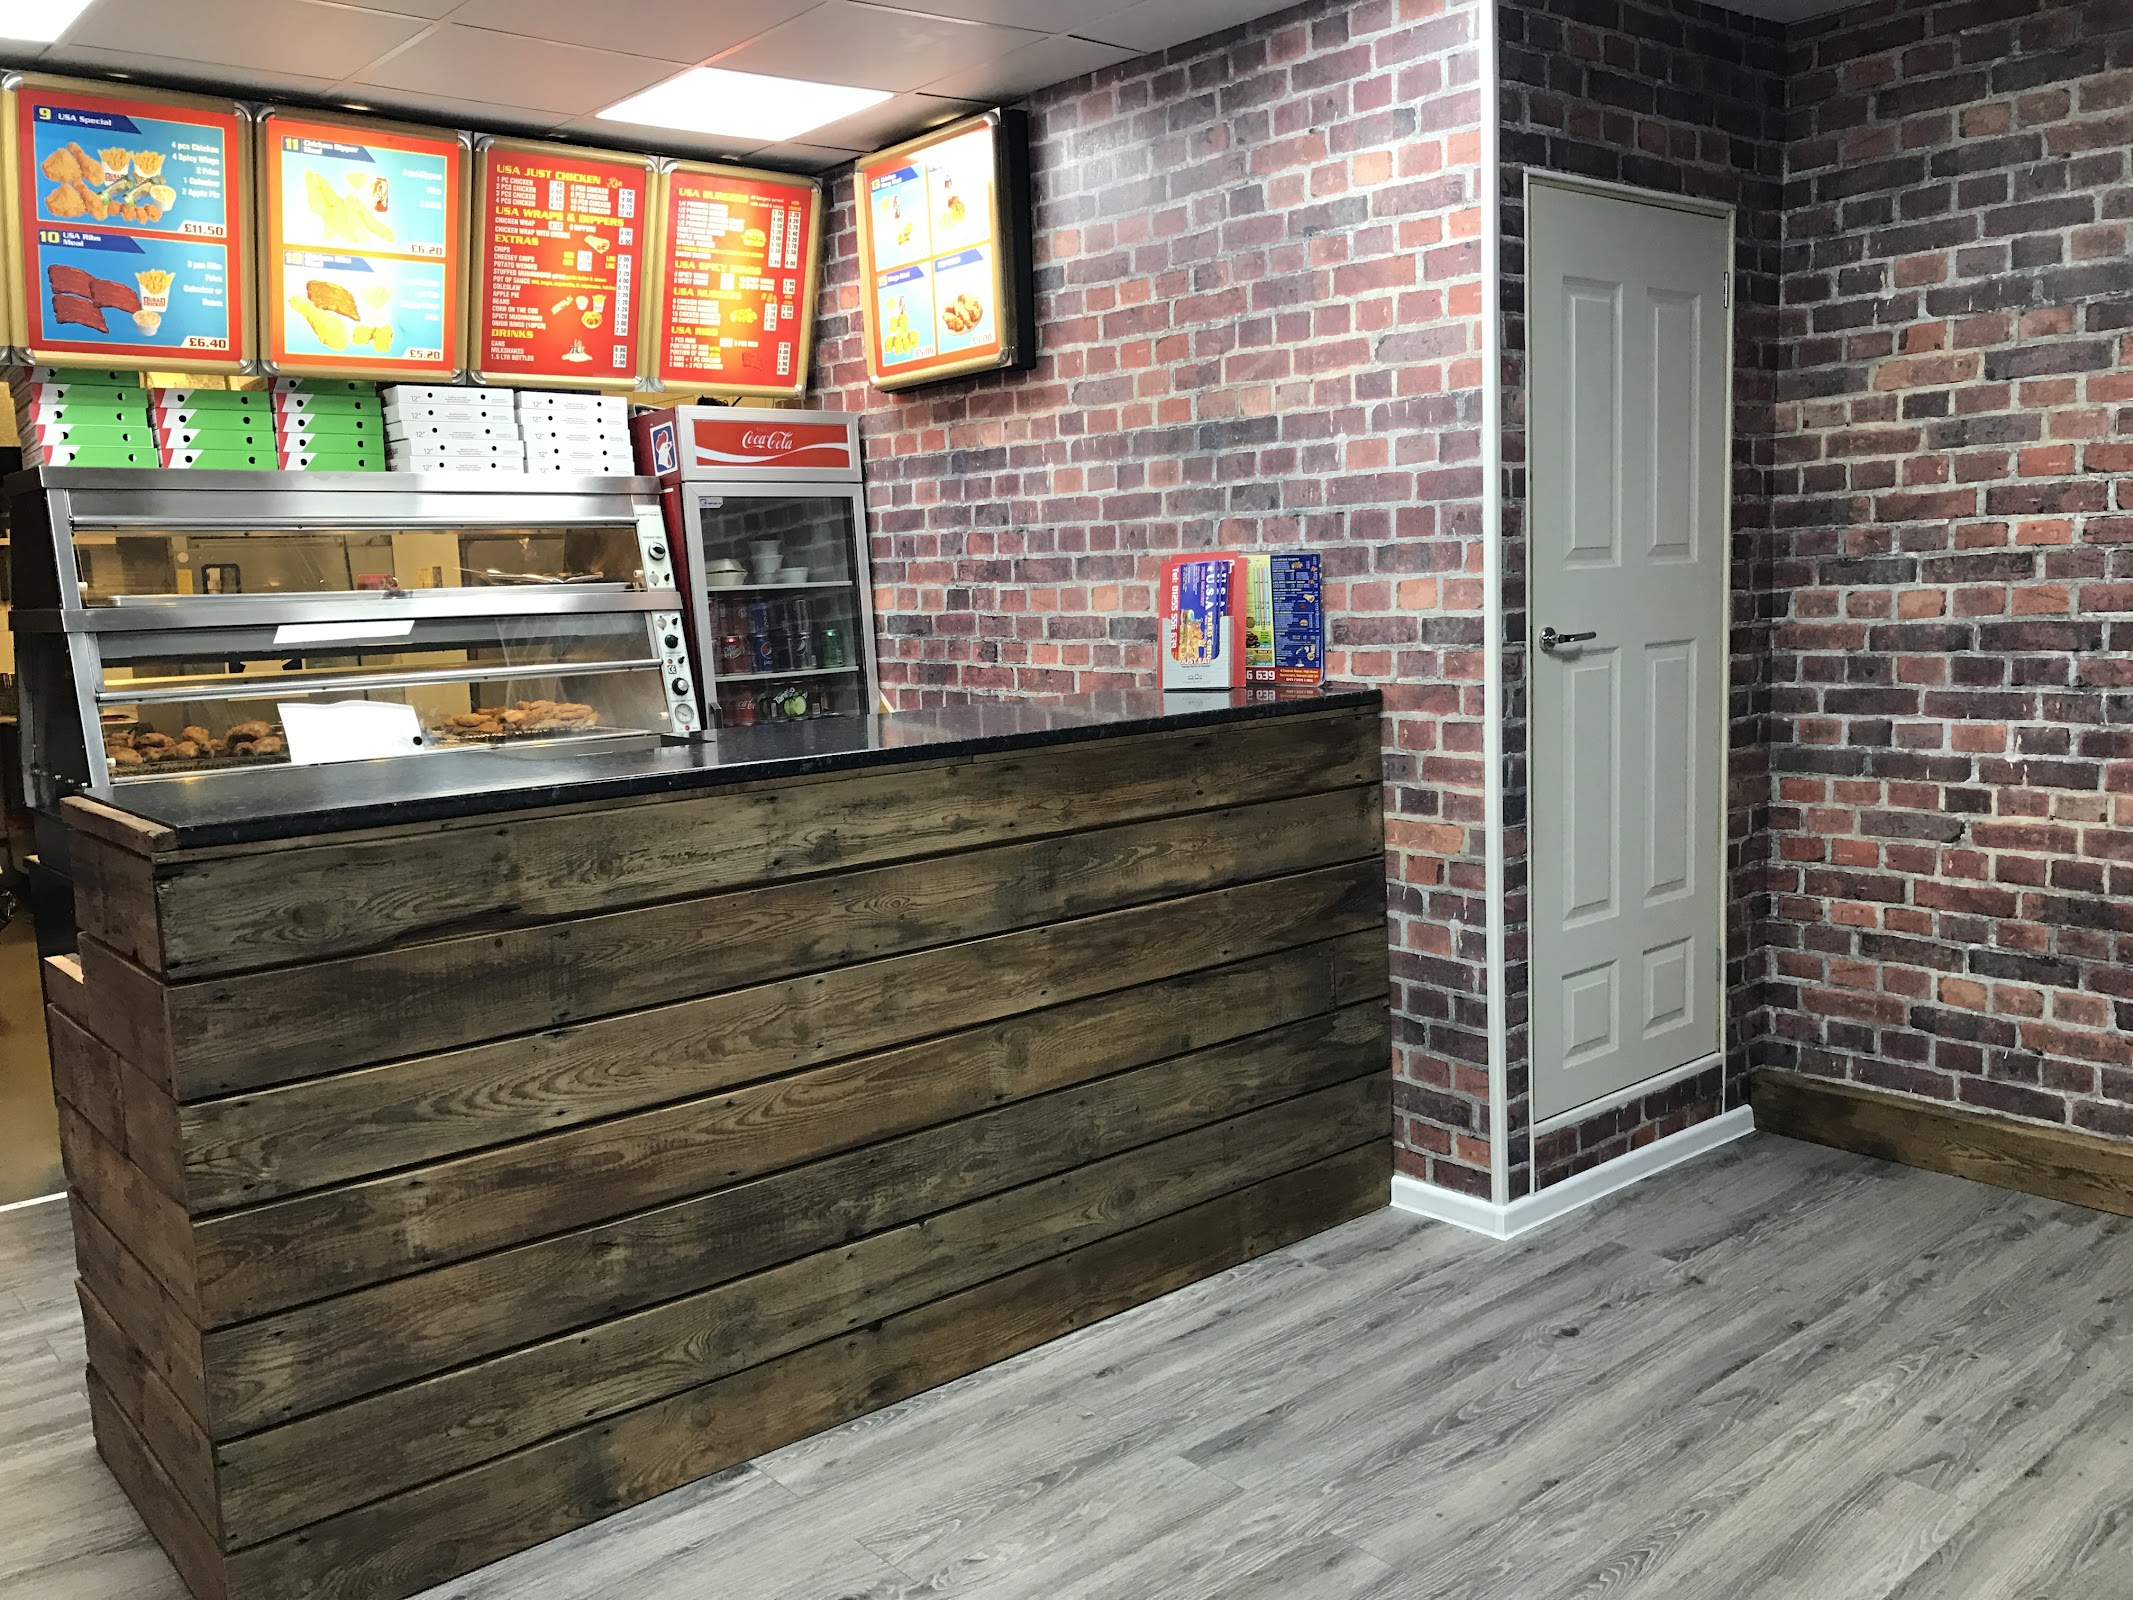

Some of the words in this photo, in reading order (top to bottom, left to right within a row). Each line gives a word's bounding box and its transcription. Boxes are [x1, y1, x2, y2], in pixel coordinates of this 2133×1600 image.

[39, 107, 51, 120] 9
[58, 113, 77, 122] USA
[79, 116, 112, 126] Special
[191, 144, 219, 153] Chicken
[285, 138, 298, 151] 11
[496, 164, 520, 176] USA
[524, 168, 552, 179] JUST
[555, 171, 601, 185] CHICKEN
[510, 177, 534, 186] CHICKEN
[512, 185, 537, 194] CHICKEN
[678, 187, 700, 198] USA
[512, 192, 536, 201] CHICKEN
[512, 199, 536, 207] CHICKEN
[495, 206, 519, 217] USA
[523, 208, 564, 221] WRAPS
[566, 213, 576, 223] &
[578, 214, 624, 227] DIPPERS
[495, 216, 519, 225] CHICKEN
[519, 219, 536, 227] WRAP
[184, 223, 223, 236] £11.50
[495, 226, 518, 234] CHICKEN
[40, 231, 60, 244] 10
[82, 233, 102, 242] Ribs
[494, 234, 539, 246] EXTRAS
[63, 239, 84, 247] Meal
[411, 245, 443, 256] £6.20
[518, 255, 535, 263] CHIPS
[493, 260, 515, 269] POTATO
[515, 262, 538, 271] WEDGES
[674, 260, 696, 270] USA
[493, 268, 517, 277] STUFFED
[492, 275, 504, 283] POT
[504, 276, 513, 284] OF
[492, 283, 522, 292] COLESLAW
[673, 287, 695, 297] USA
[492, 291, 510, 299] APPLE
[510, 292, 520, 300] PIE
[491, 298, 510, 306] BEANS
[508, 306, 516, 314] ON
[516, 307, 527, 315] THE
[491, 312, 508, 321] SPICY
[508, 314, 544, 324] MUSHROOMS
[491, 320, 509, 328] ONION
[509, 321, 525, 329] RINGS
[491, 328, 534, 340] DRINKS
[671, 325, 692, 336] USA
[189, 337, 226, 349] £6.40
[490, 340, 506, 348] CANS
[410, 350, 440, 360] £5.20
[490, 346, 525, 356] MILKSHAKES
[500, 354, 511, 362] LTR
[511, 355, 535, 363] BOTTLES
[741, 430, 793, 450] Coca-Cola
[1172, 567, 1180, 583] Tel:
[1198, 657, 1211, 665] EAT
[1255, 670, 1275, 681] 639
